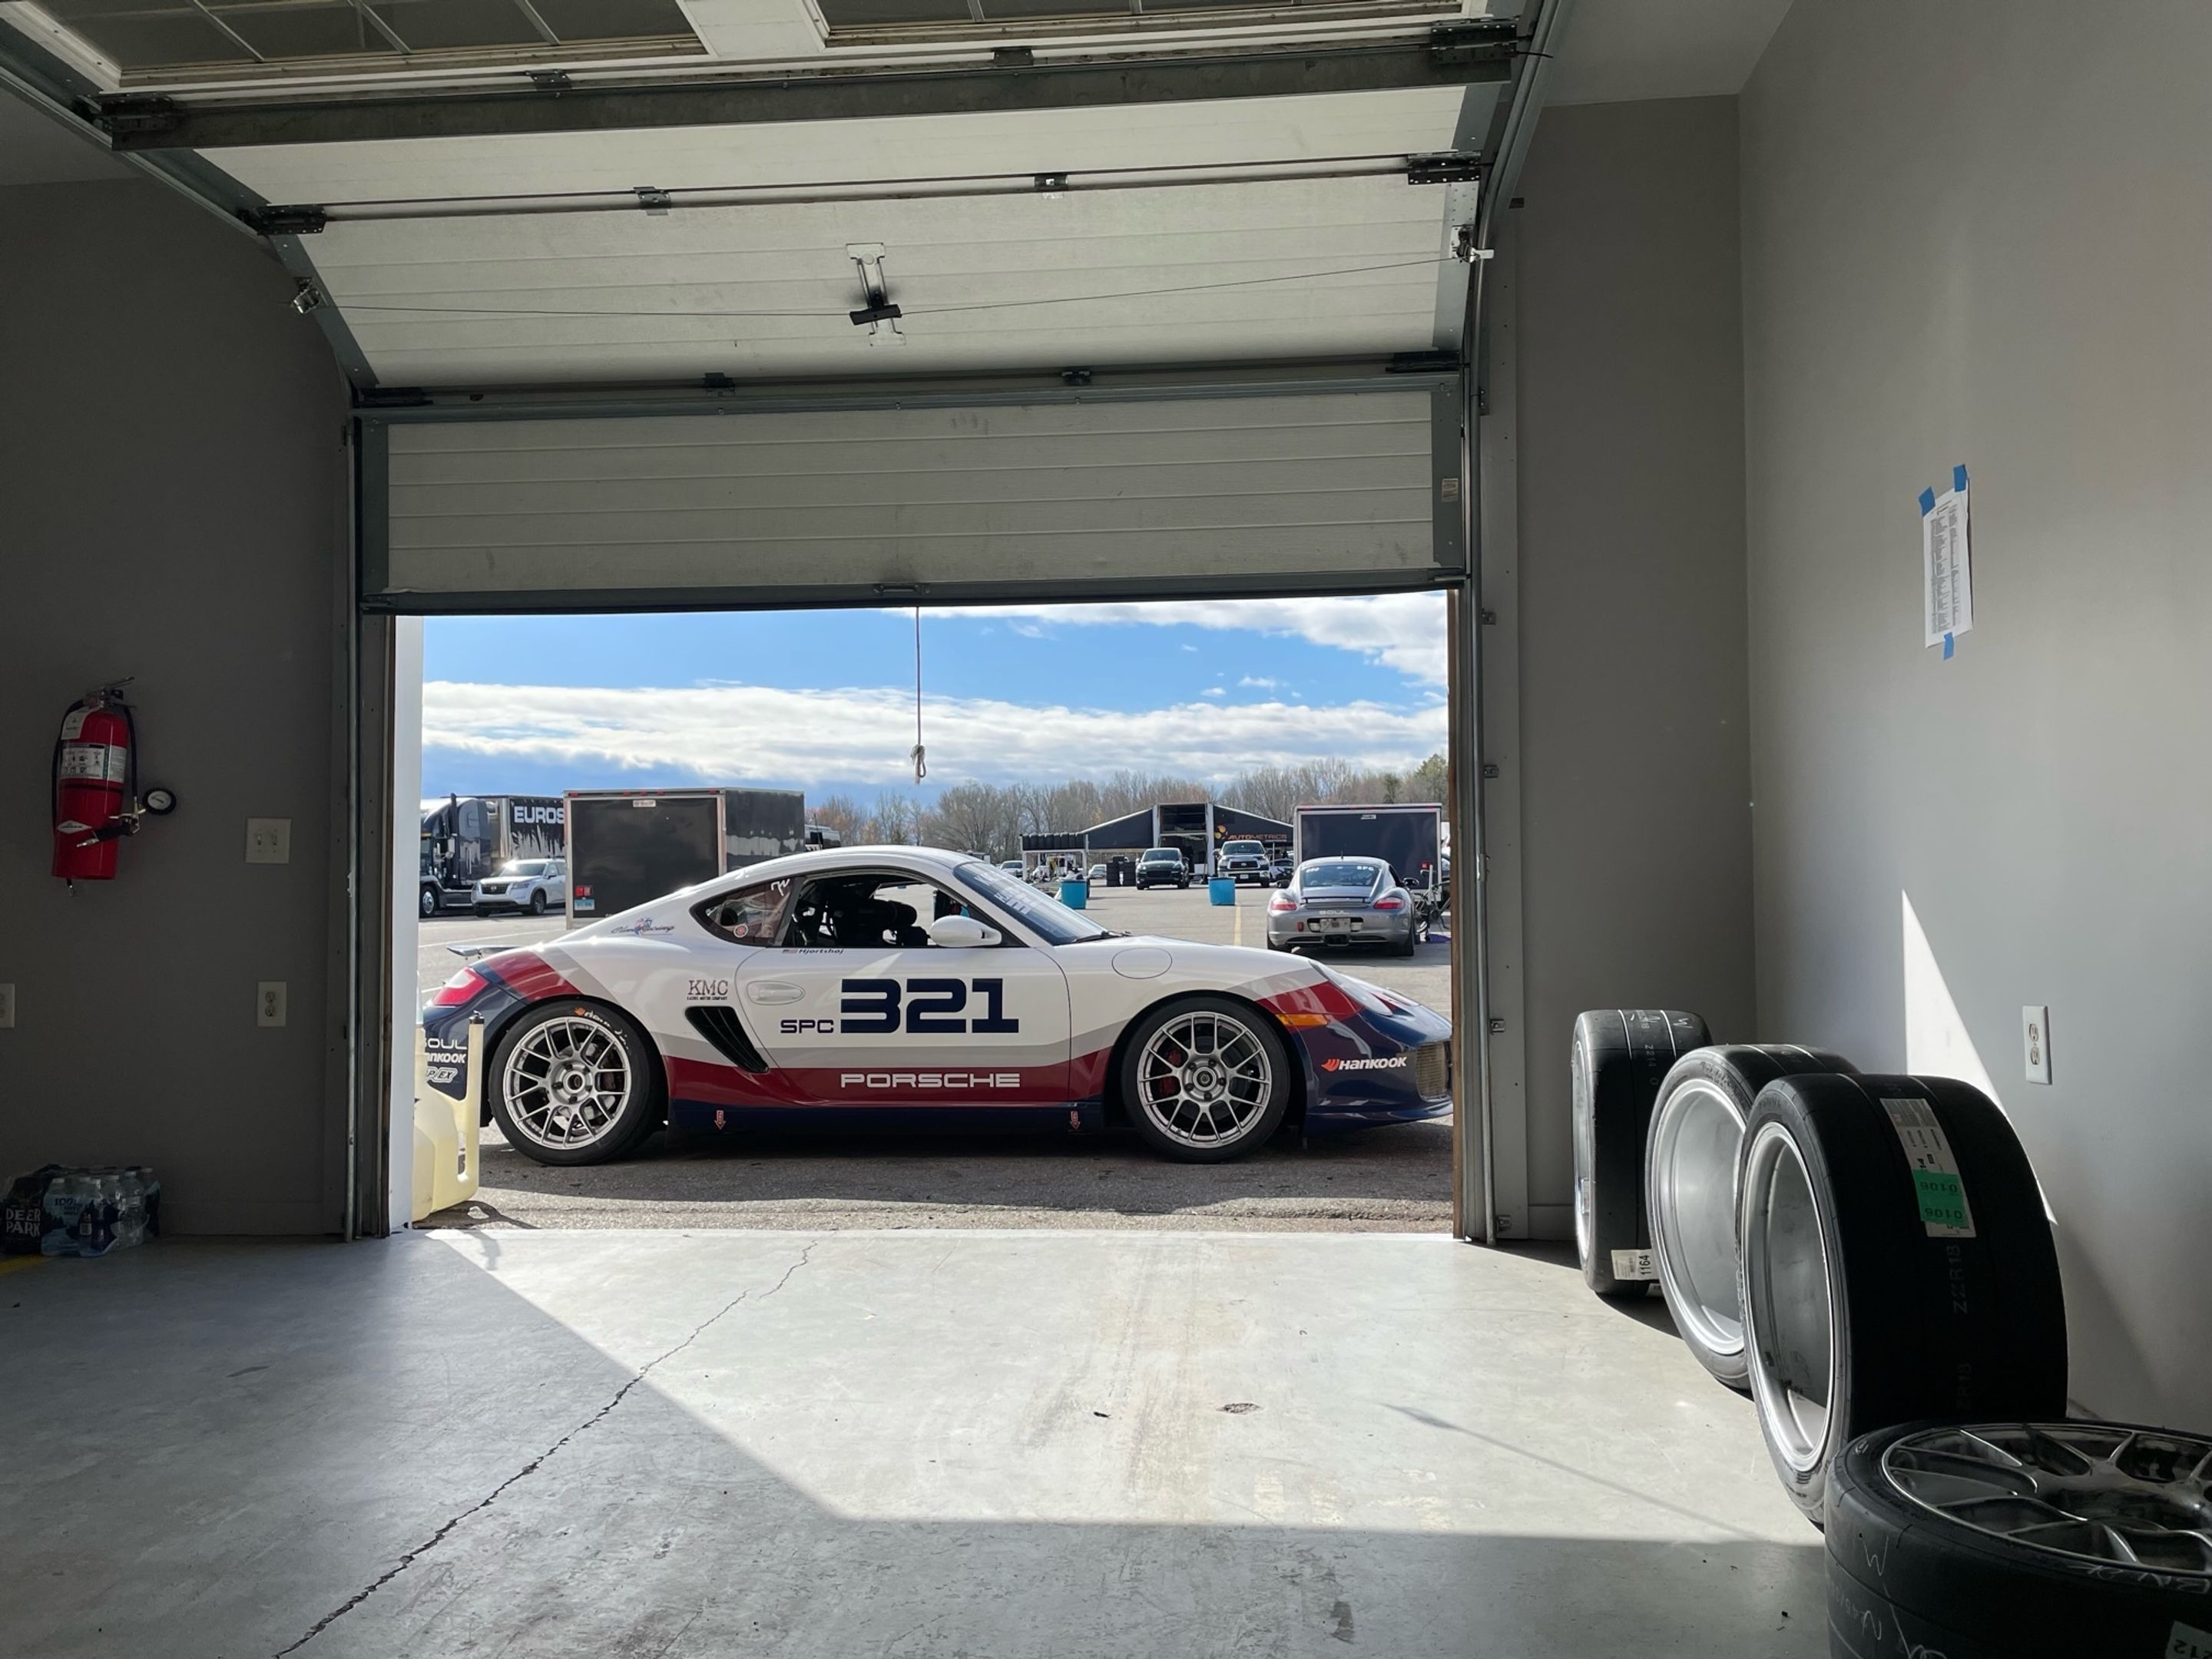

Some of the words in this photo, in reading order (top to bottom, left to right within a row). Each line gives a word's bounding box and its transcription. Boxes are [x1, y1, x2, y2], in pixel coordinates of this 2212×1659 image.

[688, 979, 728, 995] KMC
[841, 979, 1019, 1034] 321
[780, 1020, 834, 1034] SPC
[841, 1074, 1020, 1088] PORSCHE
[6, 1208, 41, 1221] DEER
[6, 1220, 41, 1238] PARK
[1639, 1254, 1651, 1276] 1164
